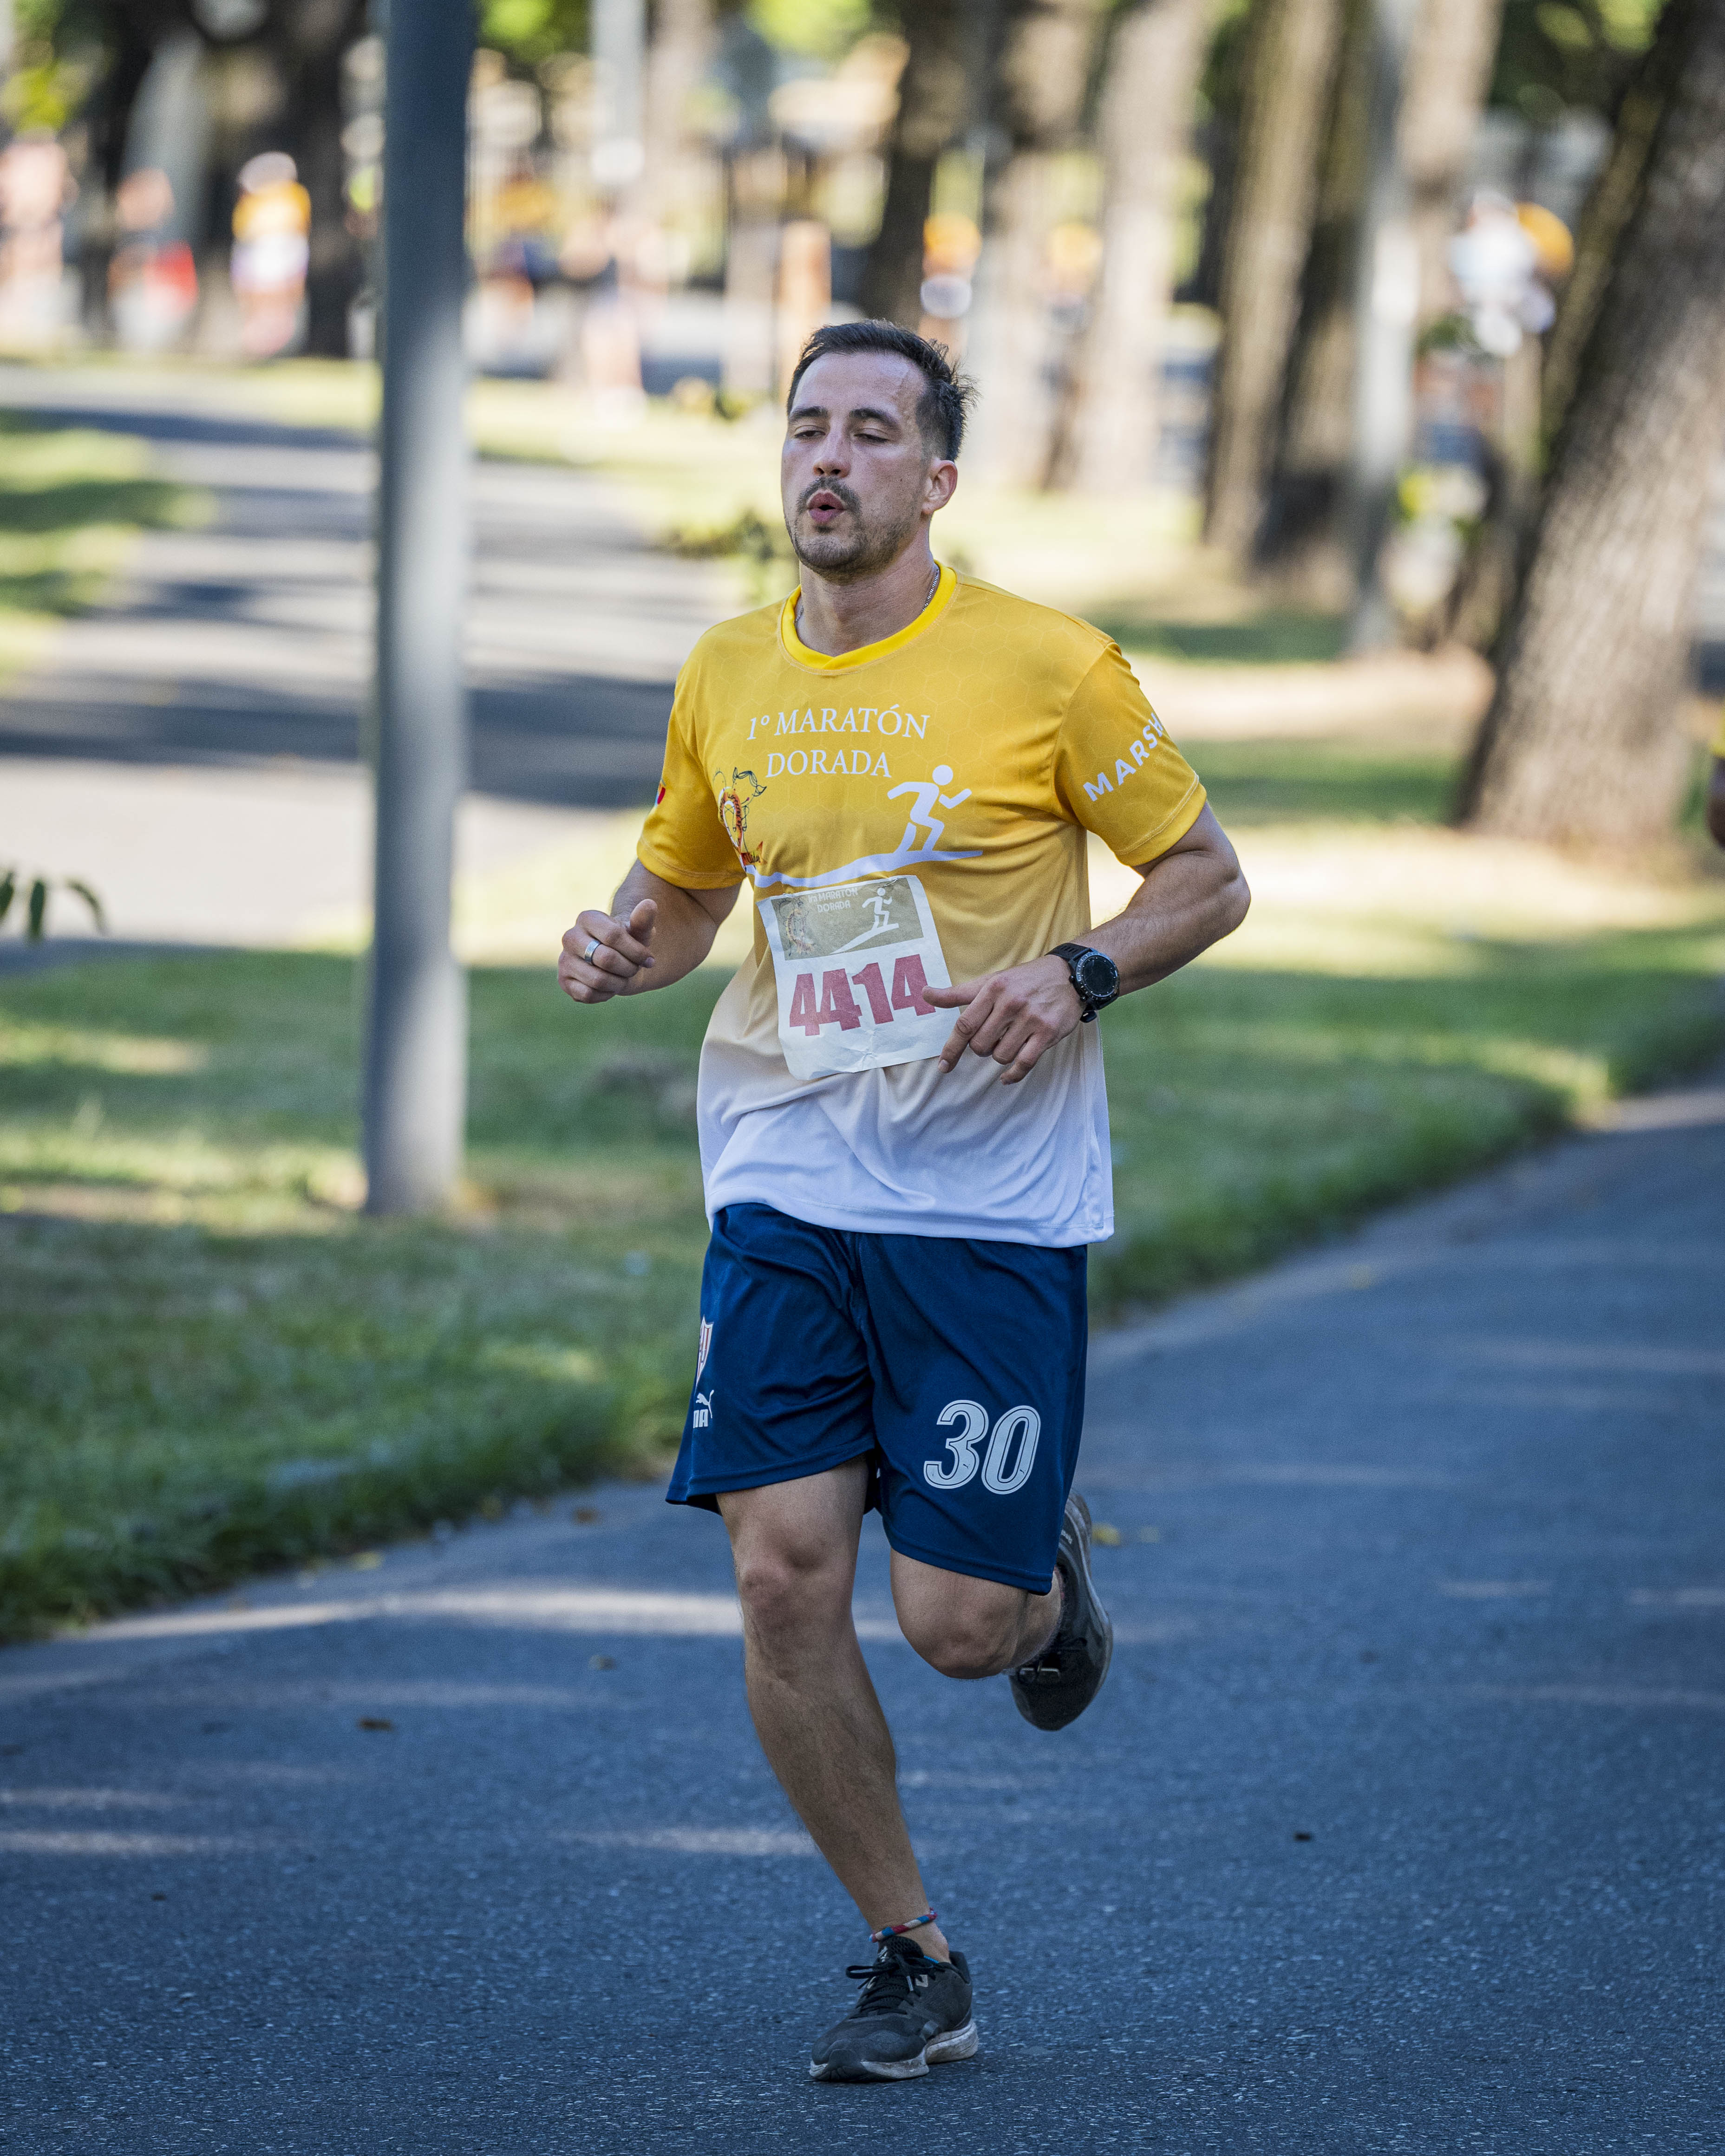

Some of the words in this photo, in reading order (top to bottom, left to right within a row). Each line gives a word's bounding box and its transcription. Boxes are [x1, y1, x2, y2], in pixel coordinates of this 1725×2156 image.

[774, 704, 930, 739] MARATÓN
[766, 749, 892, 778] DORADA
[817, 900, 850, 912] DORADA
[790, 954, 936, 1036] 4414
[923, 1400, 1041, 1495] 30
